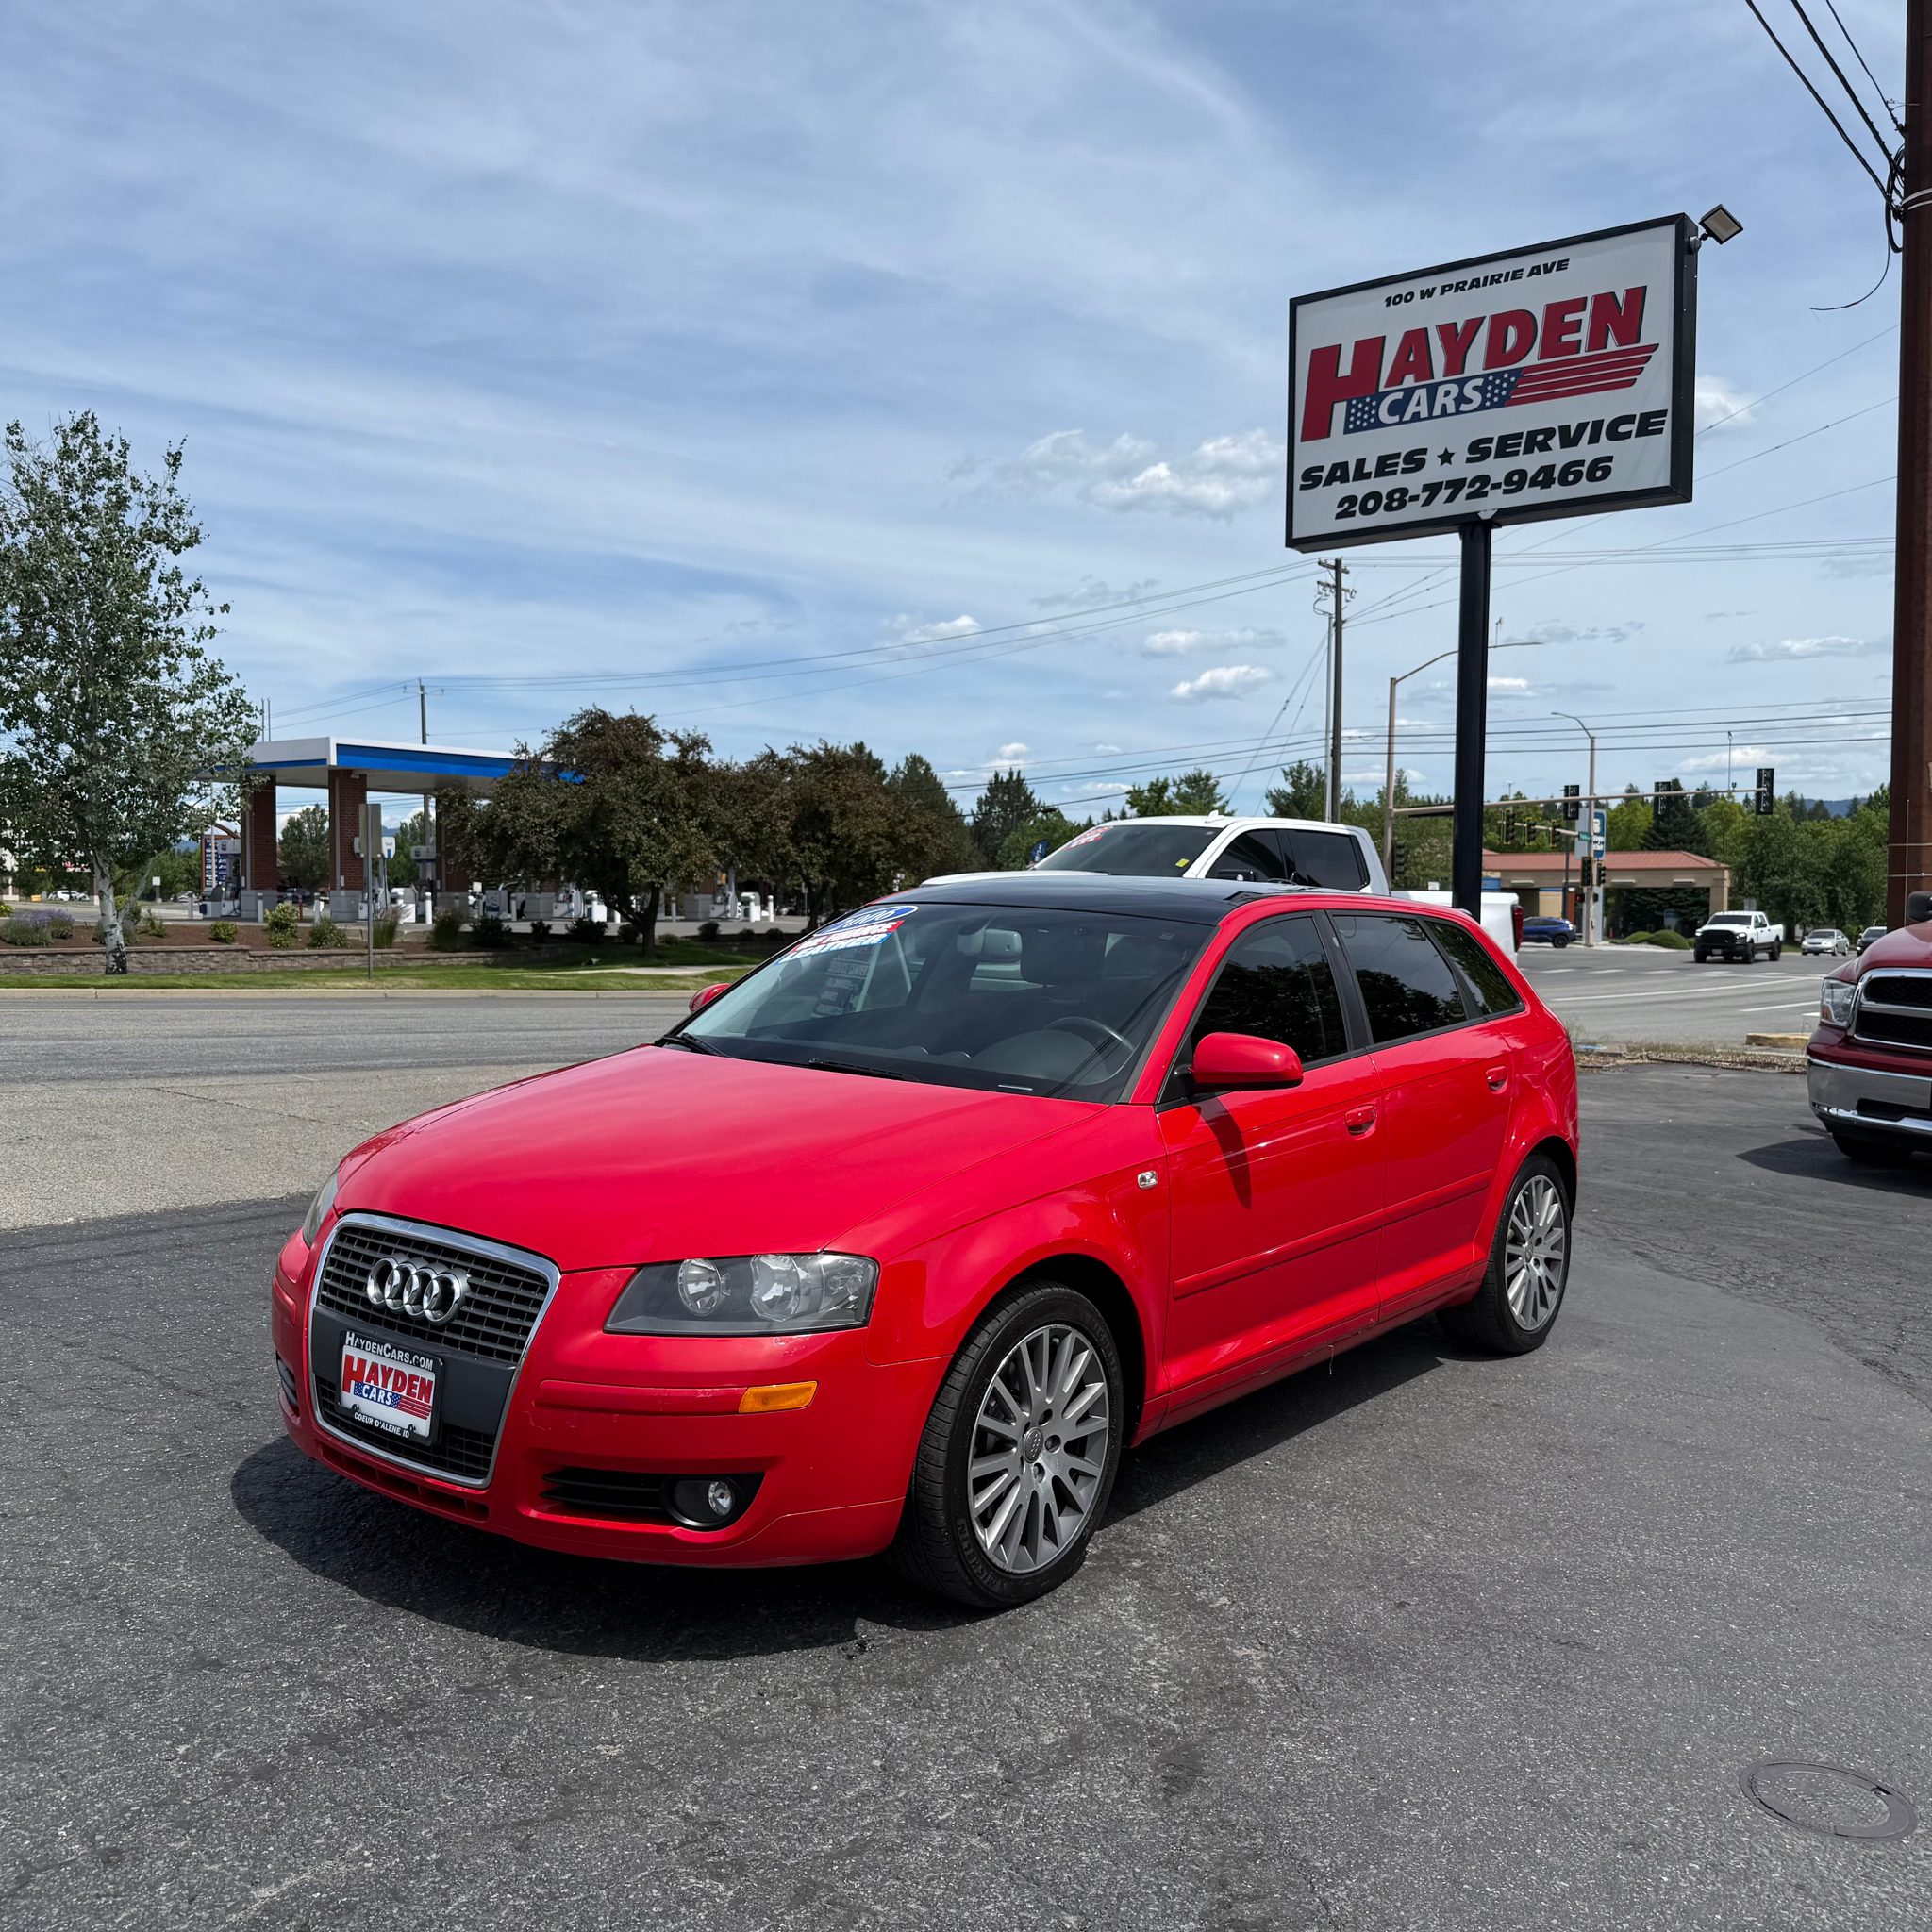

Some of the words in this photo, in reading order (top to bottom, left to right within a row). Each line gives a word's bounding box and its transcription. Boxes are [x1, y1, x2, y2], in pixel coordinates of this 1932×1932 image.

[1385, 291, 1414, 307] 100
[1418, 286, 1436, 300] W
[1440, 267, 1524, 296] PRAIRIE
[1526, 258, 1570, 279] AVE
[1300, 285, 1647, 442] HAYDEN
[1377, 377, 1485, 425] CARS
[1299, 447, 1428, 491] SALES
[1465, 408, 1668, 464] SERVICE
[1335, 456, 1613, 520] 208-772-9466
[342, 1355, 433, 1403] HAYDEN
[362, 1385, 392, 1405] CARS
[354, 1412, 374, 1425] COEUR
[402, 1428, 410, 1439] ID
